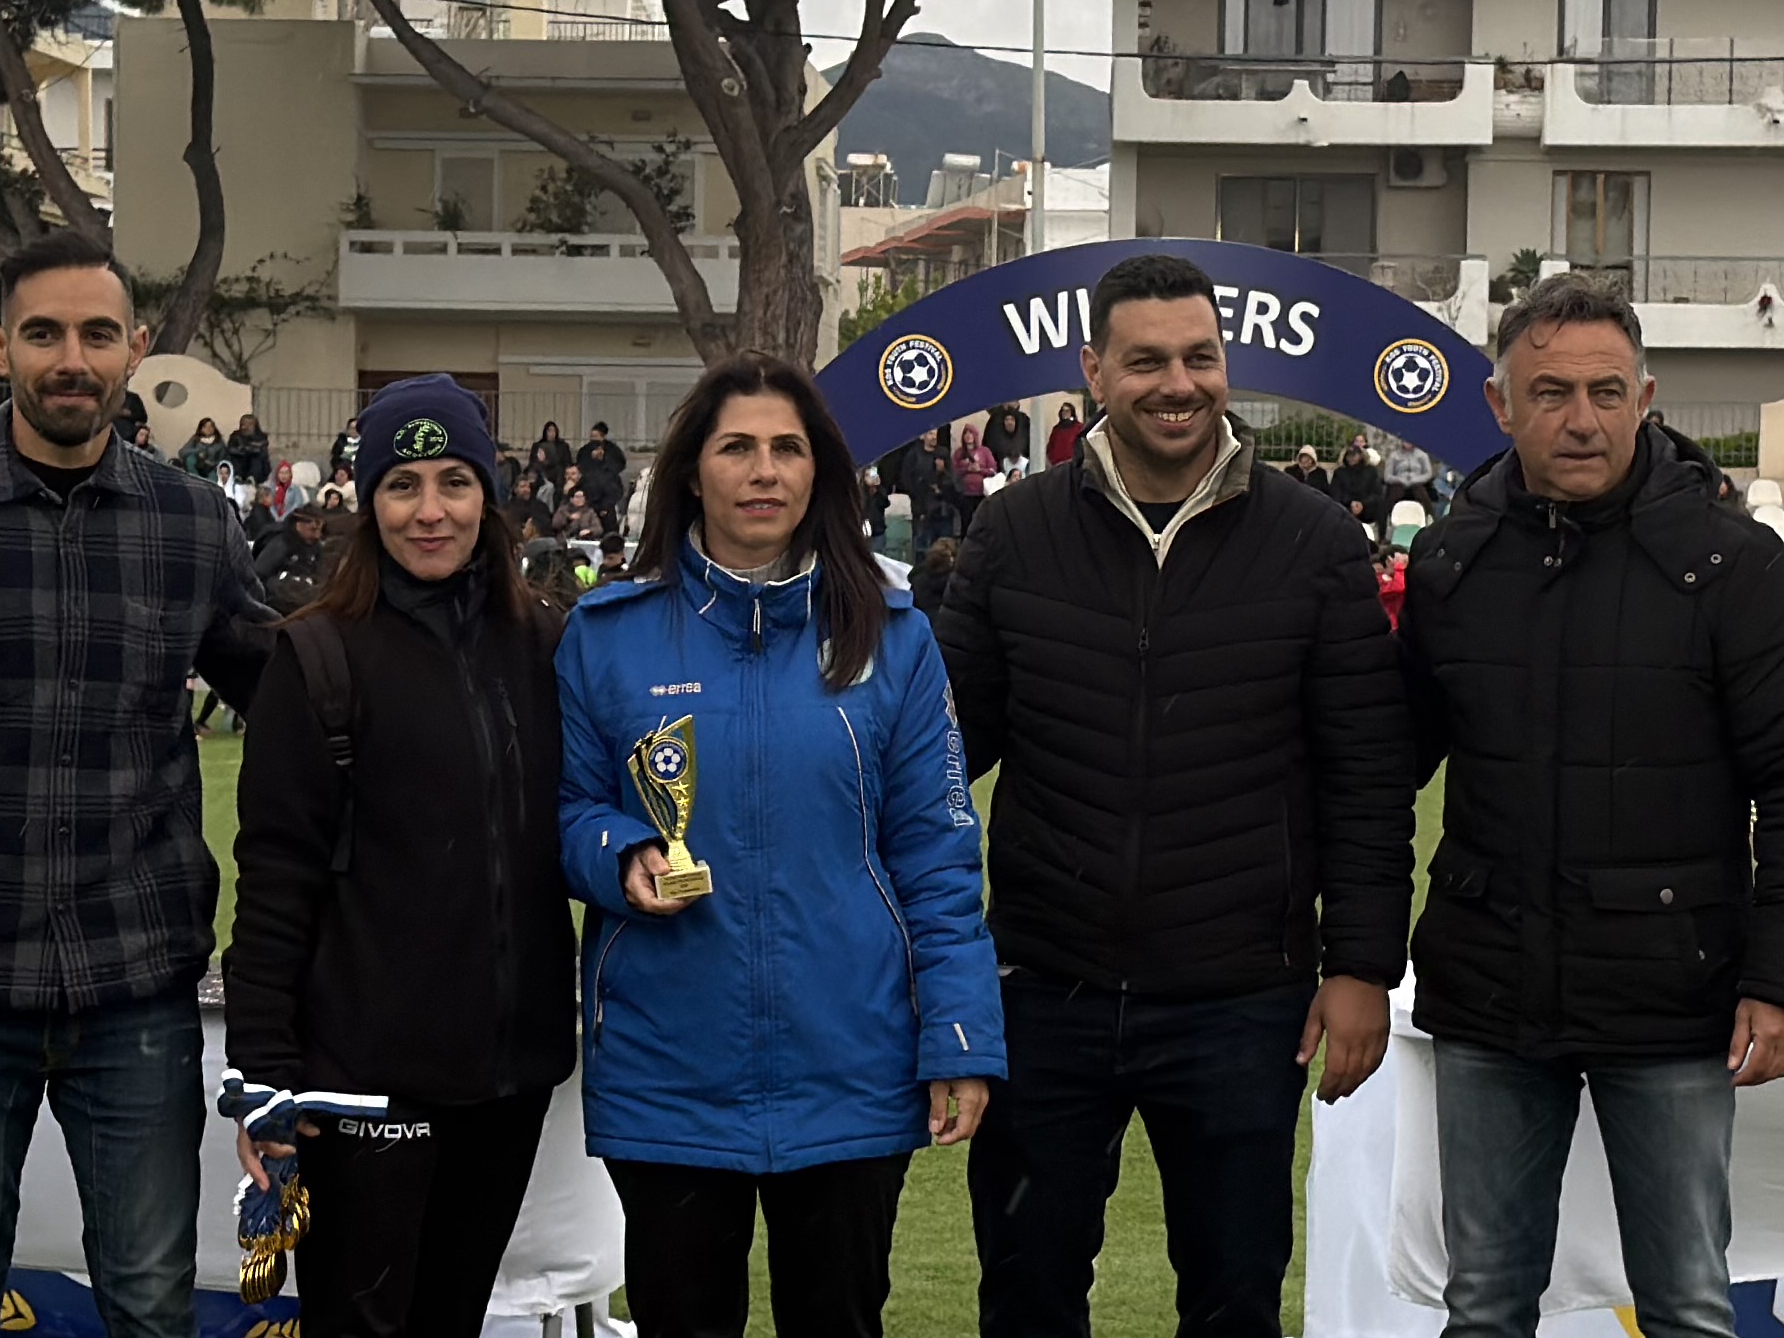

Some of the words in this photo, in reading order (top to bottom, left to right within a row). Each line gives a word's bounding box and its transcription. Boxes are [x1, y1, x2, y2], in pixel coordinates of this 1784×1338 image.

[1002, 284, 1320, 356] WIERS
[909, 340, 943, 363] FESTIVAL
[338, 1118, 431, 1139] GIVOVA
